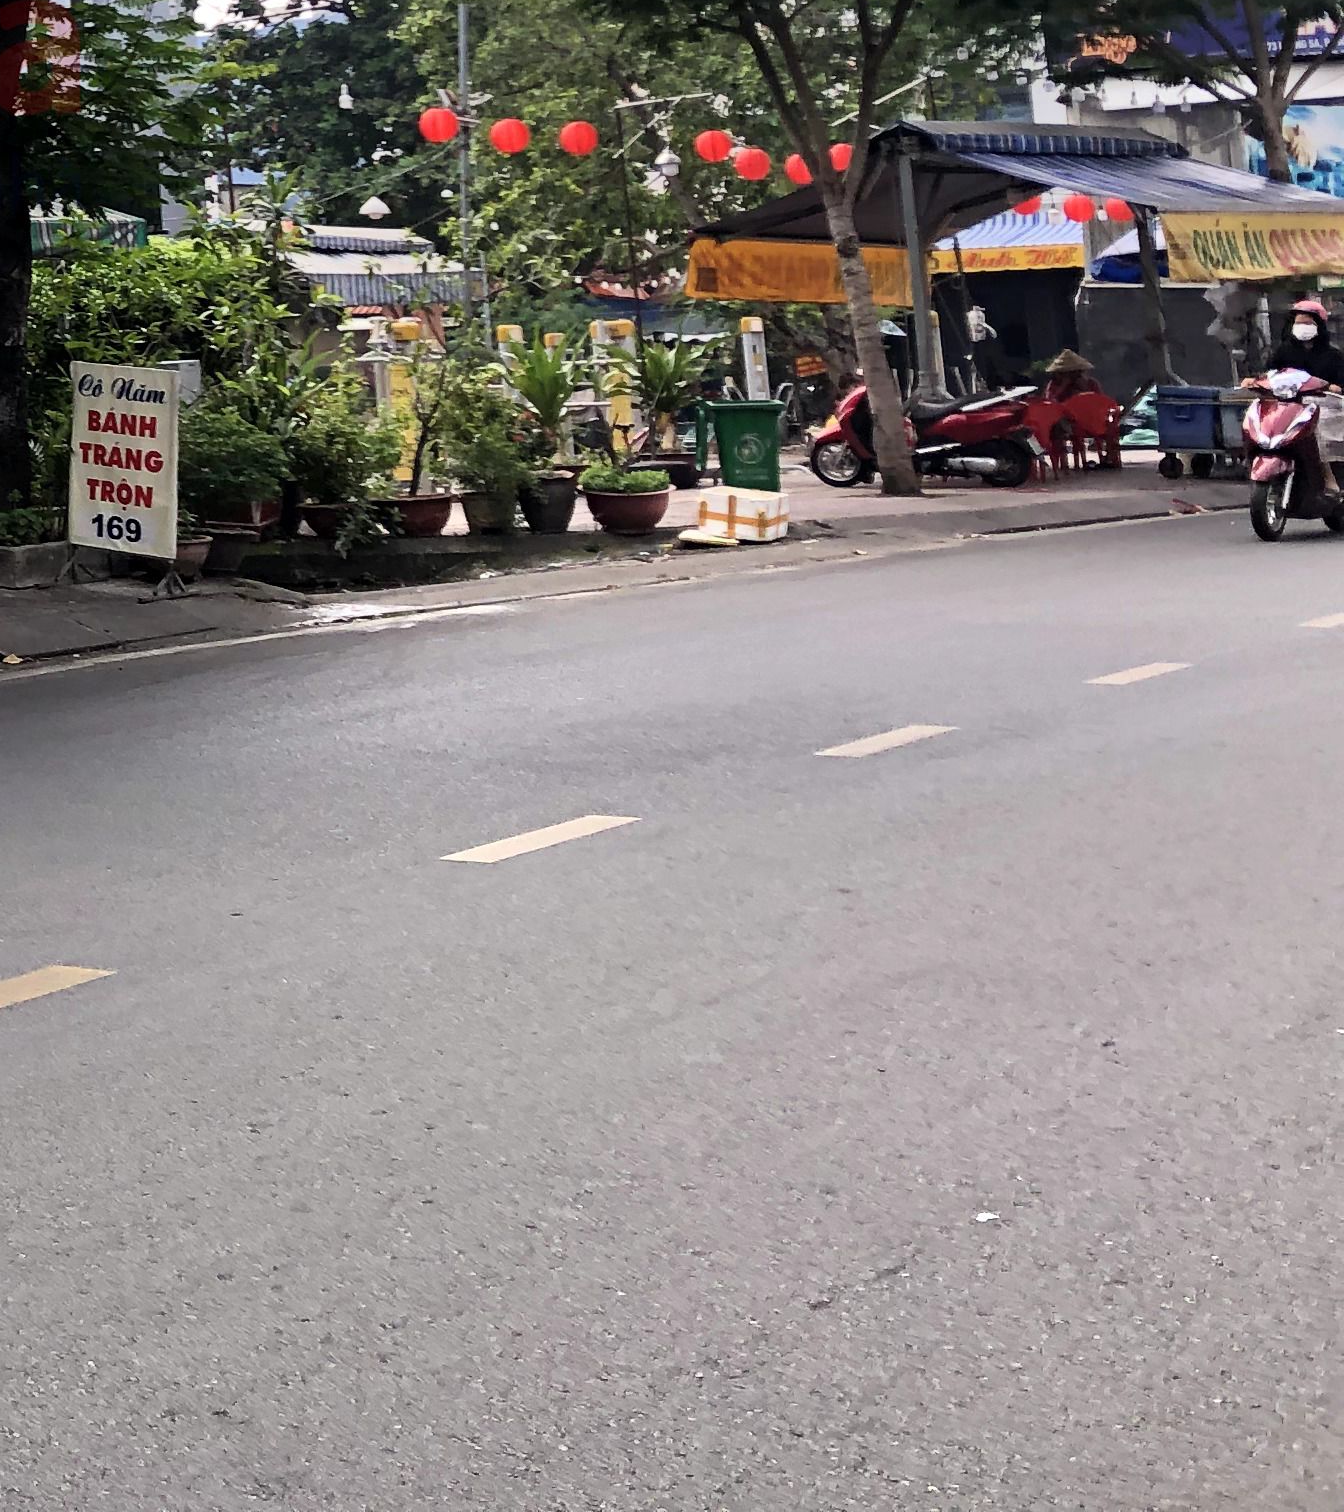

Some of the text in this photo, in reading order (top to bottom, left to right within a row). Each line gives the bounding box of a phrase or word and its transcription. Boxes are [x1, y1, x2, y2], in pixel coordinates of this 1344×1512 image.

[78, 374, 167, 405] Cô Năm
[88, 407, 157, 439] BÁNH
[79, 441, 164, 473] TRÁNG
[87, 478, 153, 511] TRỘN
[91, 514, 142, 542] 169
